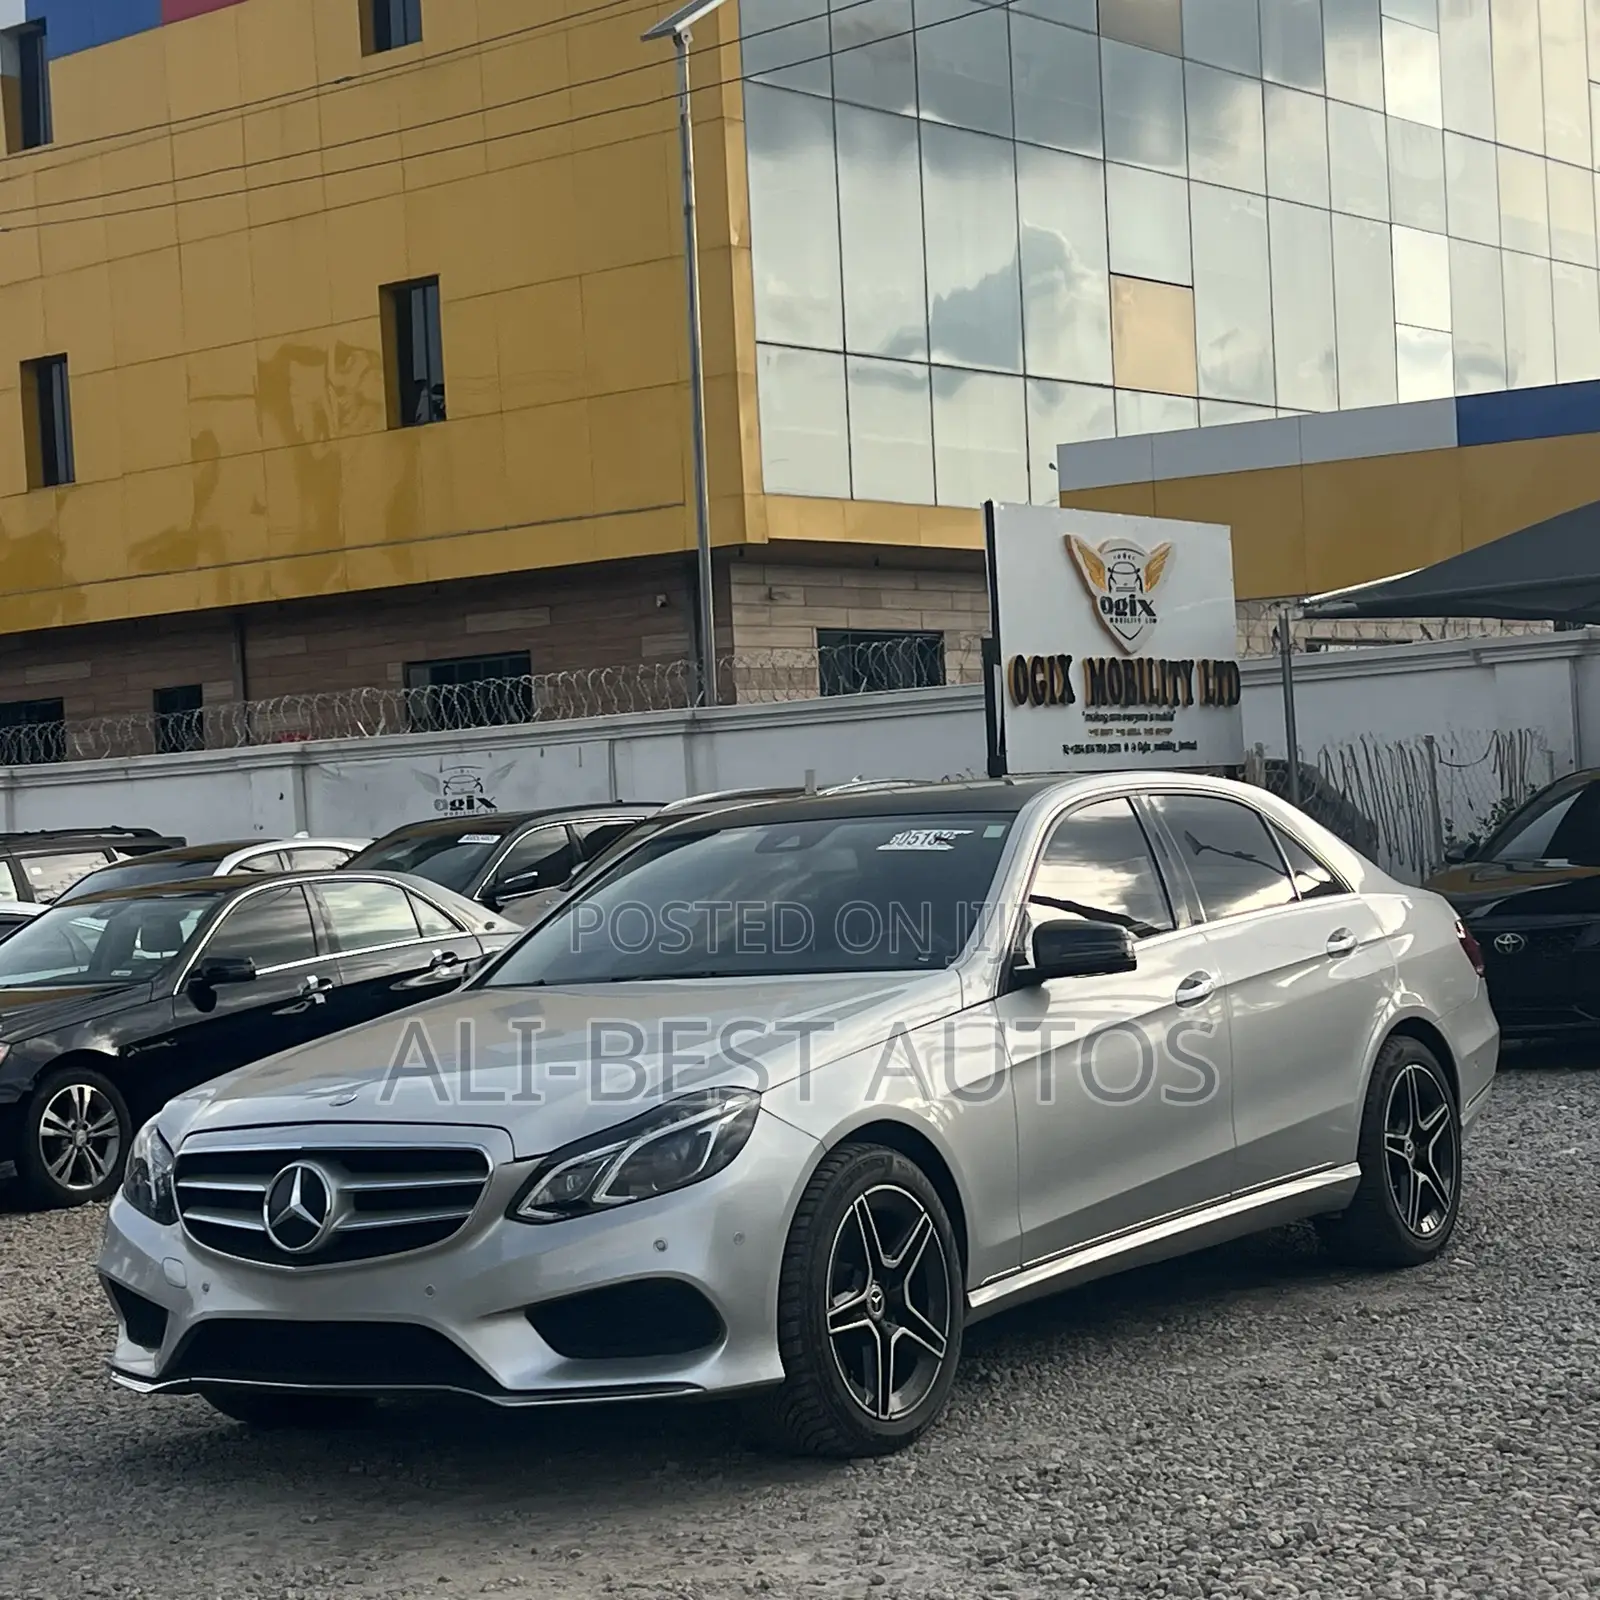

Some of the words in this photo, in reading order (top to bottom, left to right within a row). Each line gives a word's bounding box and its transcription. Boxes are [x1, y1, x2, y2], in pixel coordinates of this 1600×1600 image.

[1008, 654, 1076, 706] OGIX
[1082, 656, 1195, 707] MOBILITY
[1196, 658, 1241, 706] LTD
